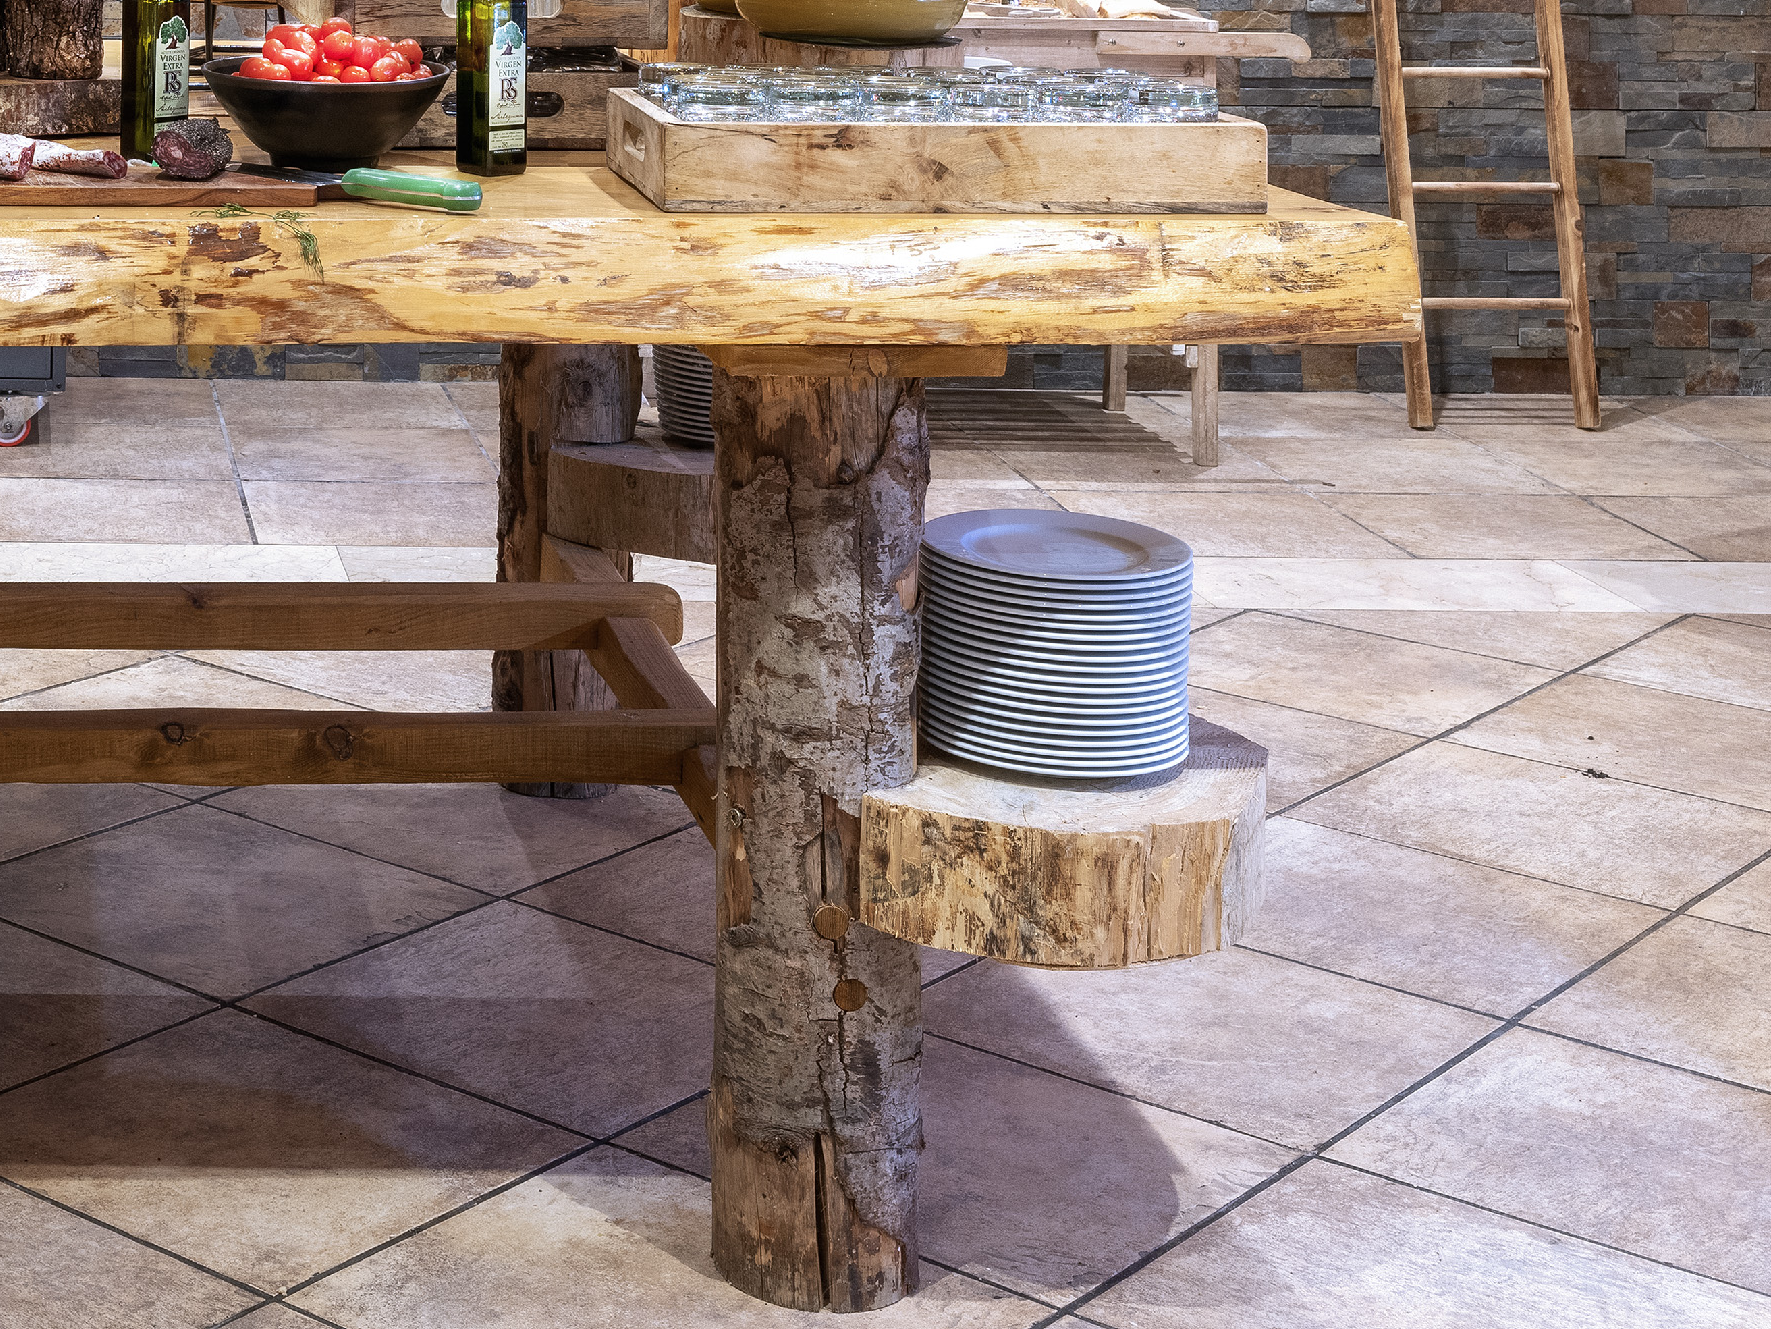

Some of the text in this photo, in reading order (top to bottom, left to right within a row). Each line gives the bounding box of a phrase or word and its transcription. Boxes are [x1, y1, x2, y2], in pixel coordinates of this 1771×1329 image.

[159, 54, 186, 62] VIRGEN
[163, 63, 184, 71] EXTRA
[495, 61, 522, 69] VIRGEN
